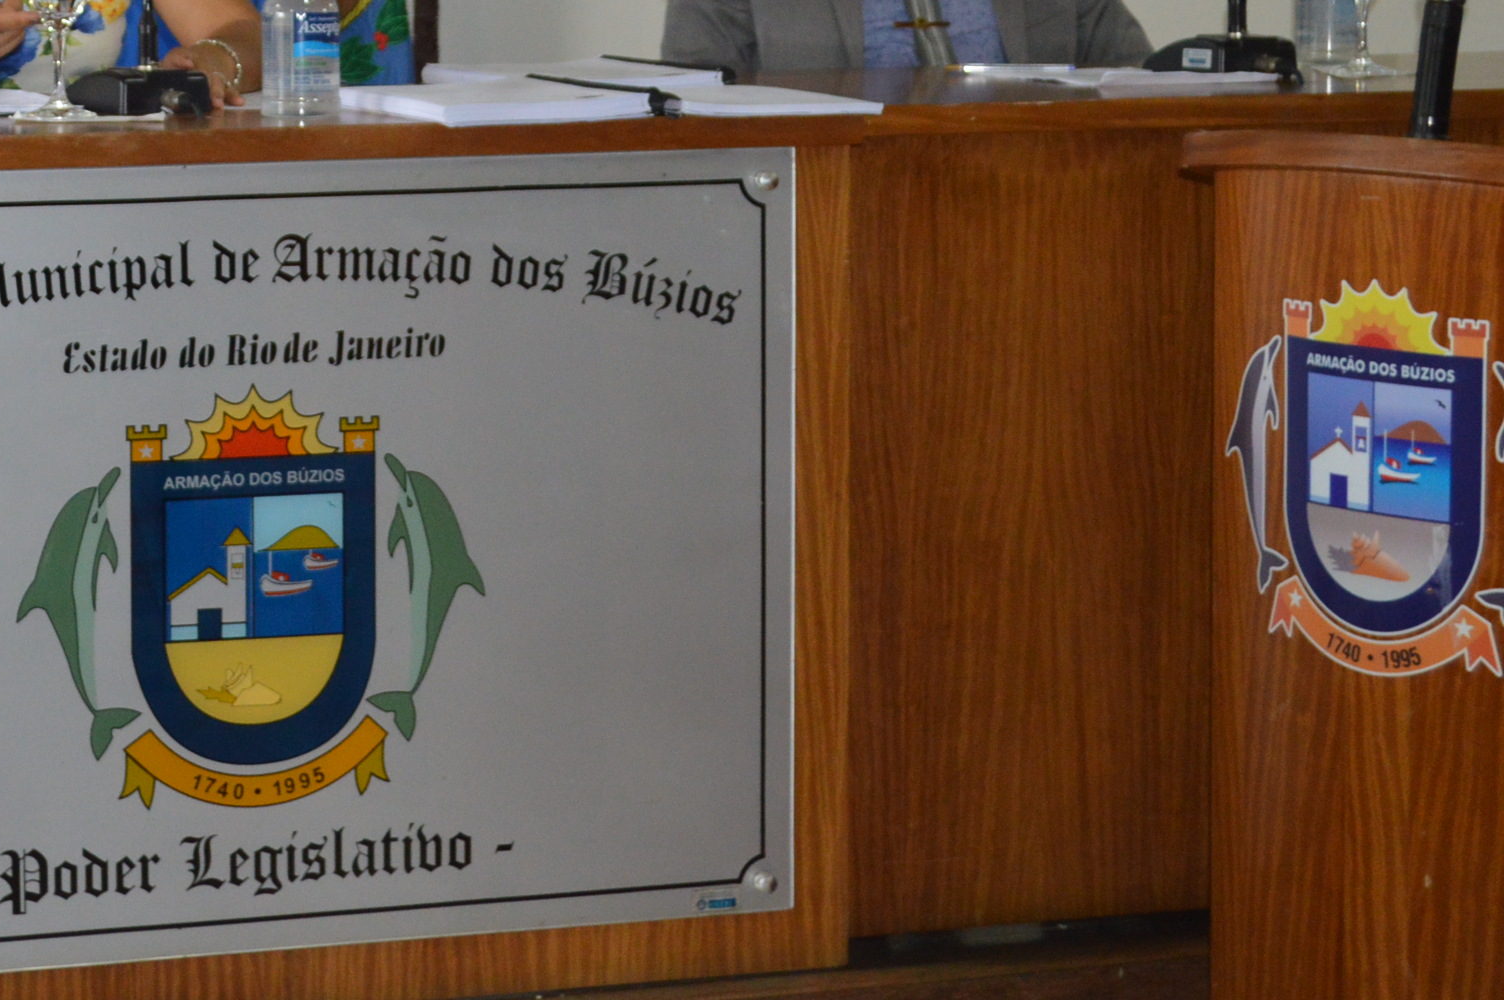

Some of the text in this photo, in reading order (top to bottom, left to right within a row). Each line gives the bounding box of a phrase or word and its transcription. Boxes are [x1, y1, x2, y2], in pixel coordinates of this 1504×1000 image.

[212, 239, 259, 284] de
[272, 232, 472, 299] Armação
[491, 242, 569, 292] dos
[582, 249, 743, 325] Búzios
[62, 326, 446, 374] Estado do Rio de Janeiro
[1306, 351, 1456, 383] ARMAÇÃO DOS BÚZIOS
[163, 467, 345, 490] ARMAÇÃO DOS BÚZIOS
[1327, 632, 1422, 669] 1740 1995
[193, 766, 326, 800] 1740 1995
[180, 822, 473, 896] Legislativo
